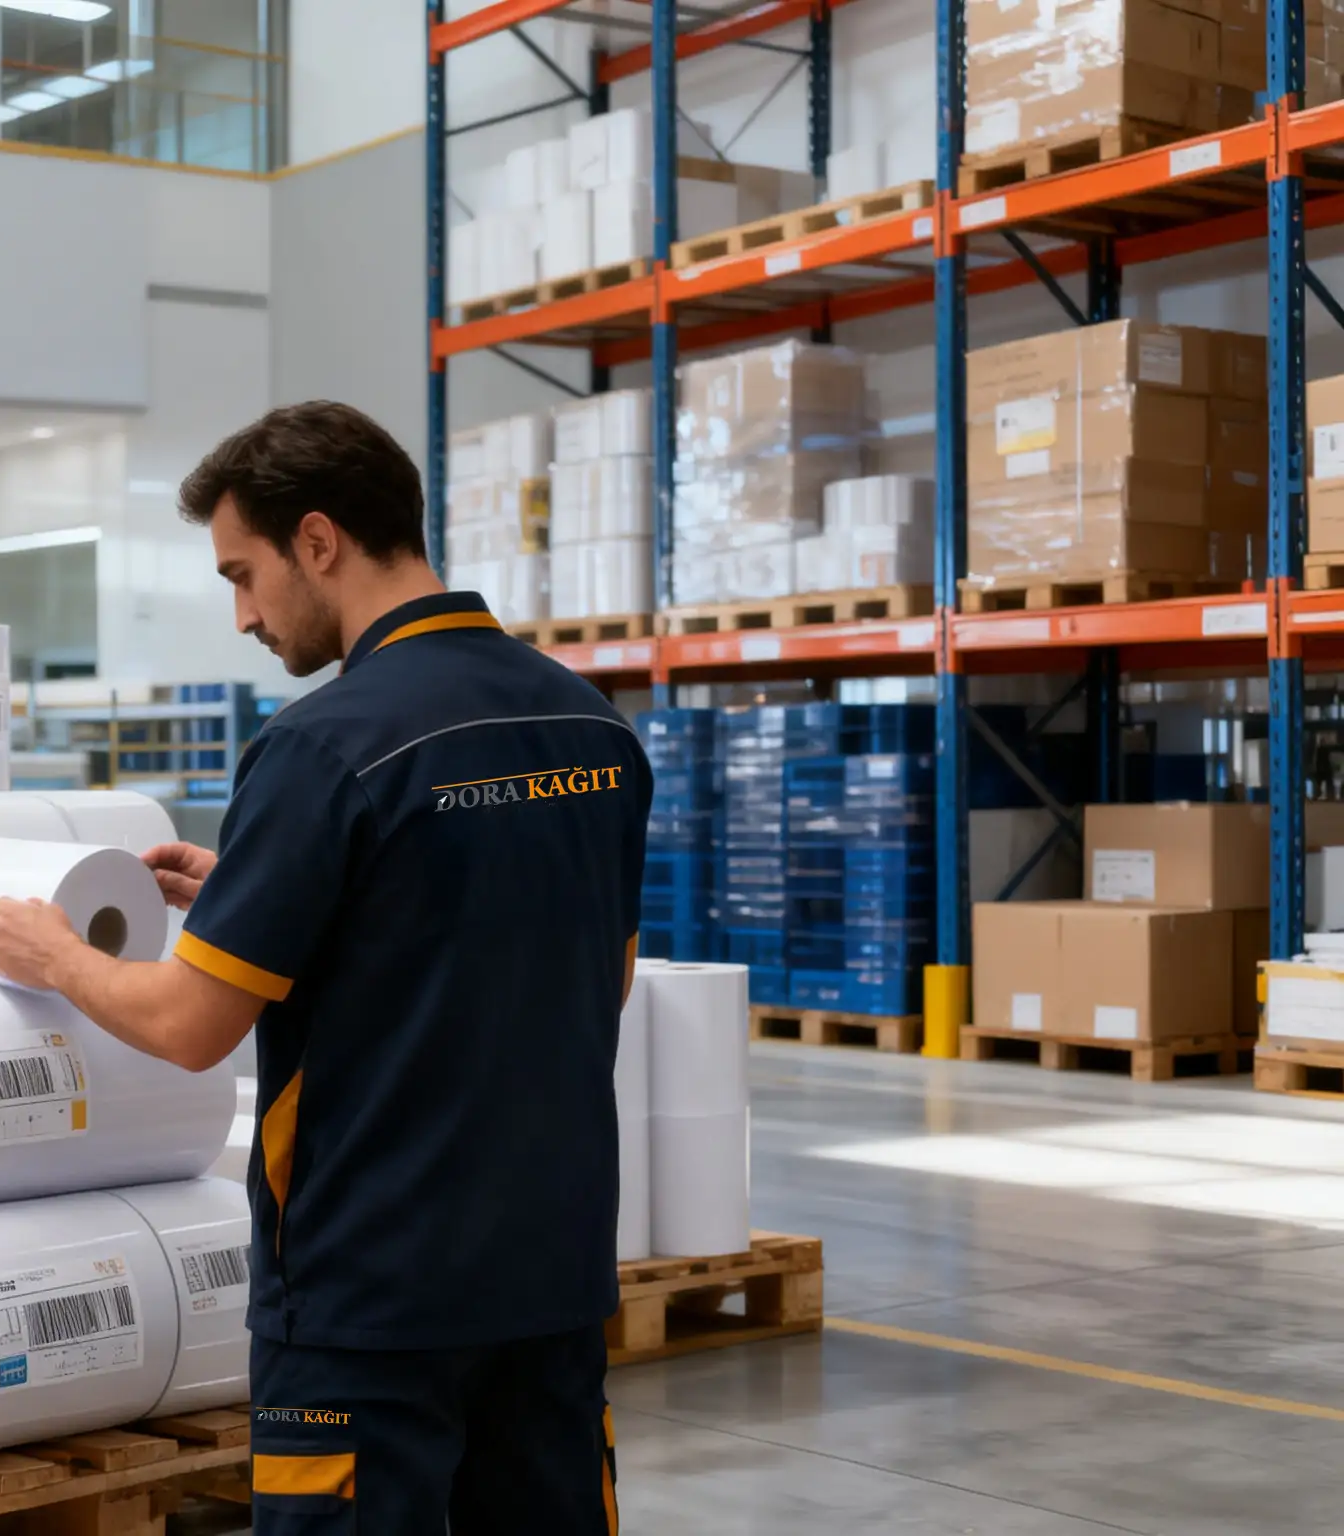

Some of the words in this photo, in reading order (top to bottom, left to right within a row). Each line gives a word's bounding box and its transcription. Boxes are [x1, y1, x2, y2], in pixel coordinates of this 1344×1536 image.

[434, 781, 522, 812] DORA
[526, 766, 621, 799] KAĞIT
[256, 1410, 300, 1422] DORA
[303, 1410, 351, 1424] KAĞIT
